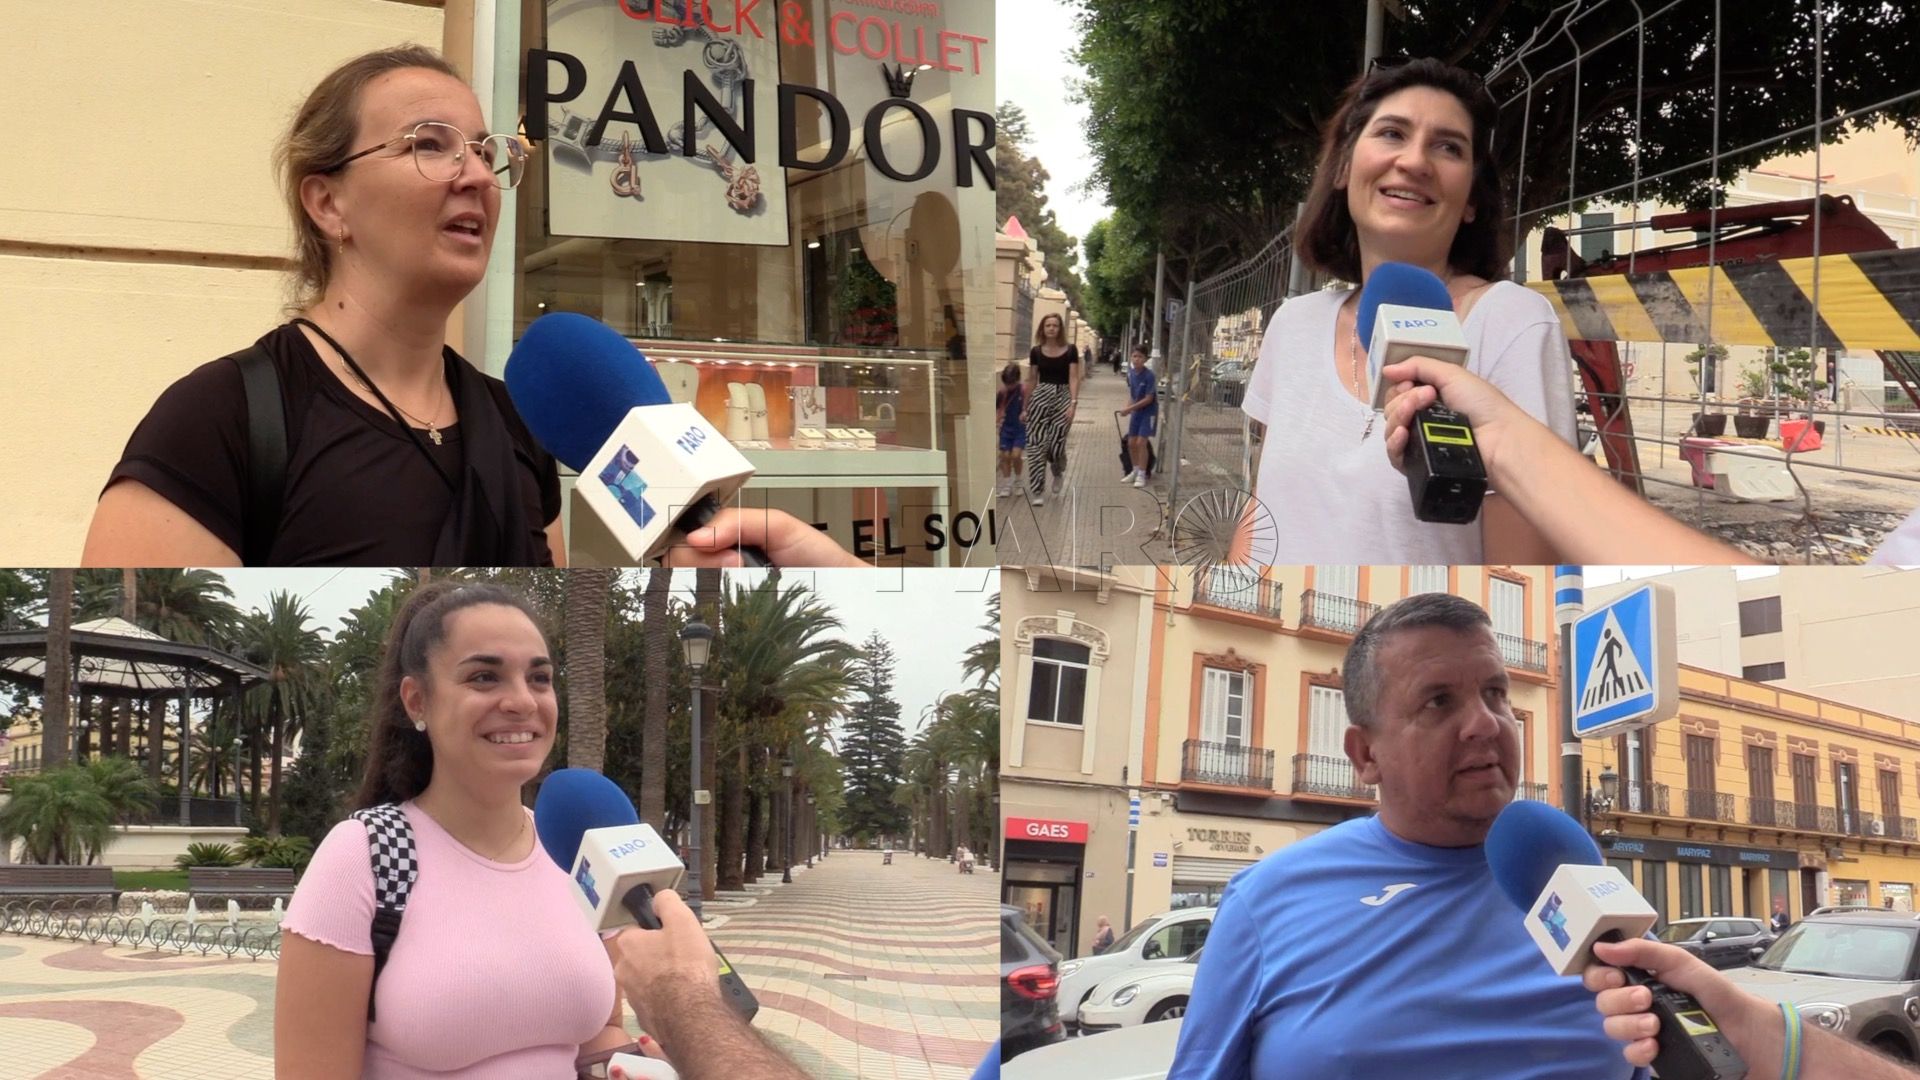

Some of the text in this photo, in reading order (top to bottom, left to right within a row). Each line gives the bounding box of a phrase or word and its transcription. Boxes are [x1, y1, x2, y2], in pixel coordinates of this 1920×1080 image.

[782, 1, 815, 47] &
[830, 10, 988, 75] COLLET
[526, 48, 996, 191] PANDOR
[852, 518, 906, 558] EL
[1026, 823, 1069, 838] GAES
[1187, 827, 1251, 845] TORRES
[1611, 842, 1645, 853] ARYPAZ
[1677, 847, 1712, 859] MARYPAZ
